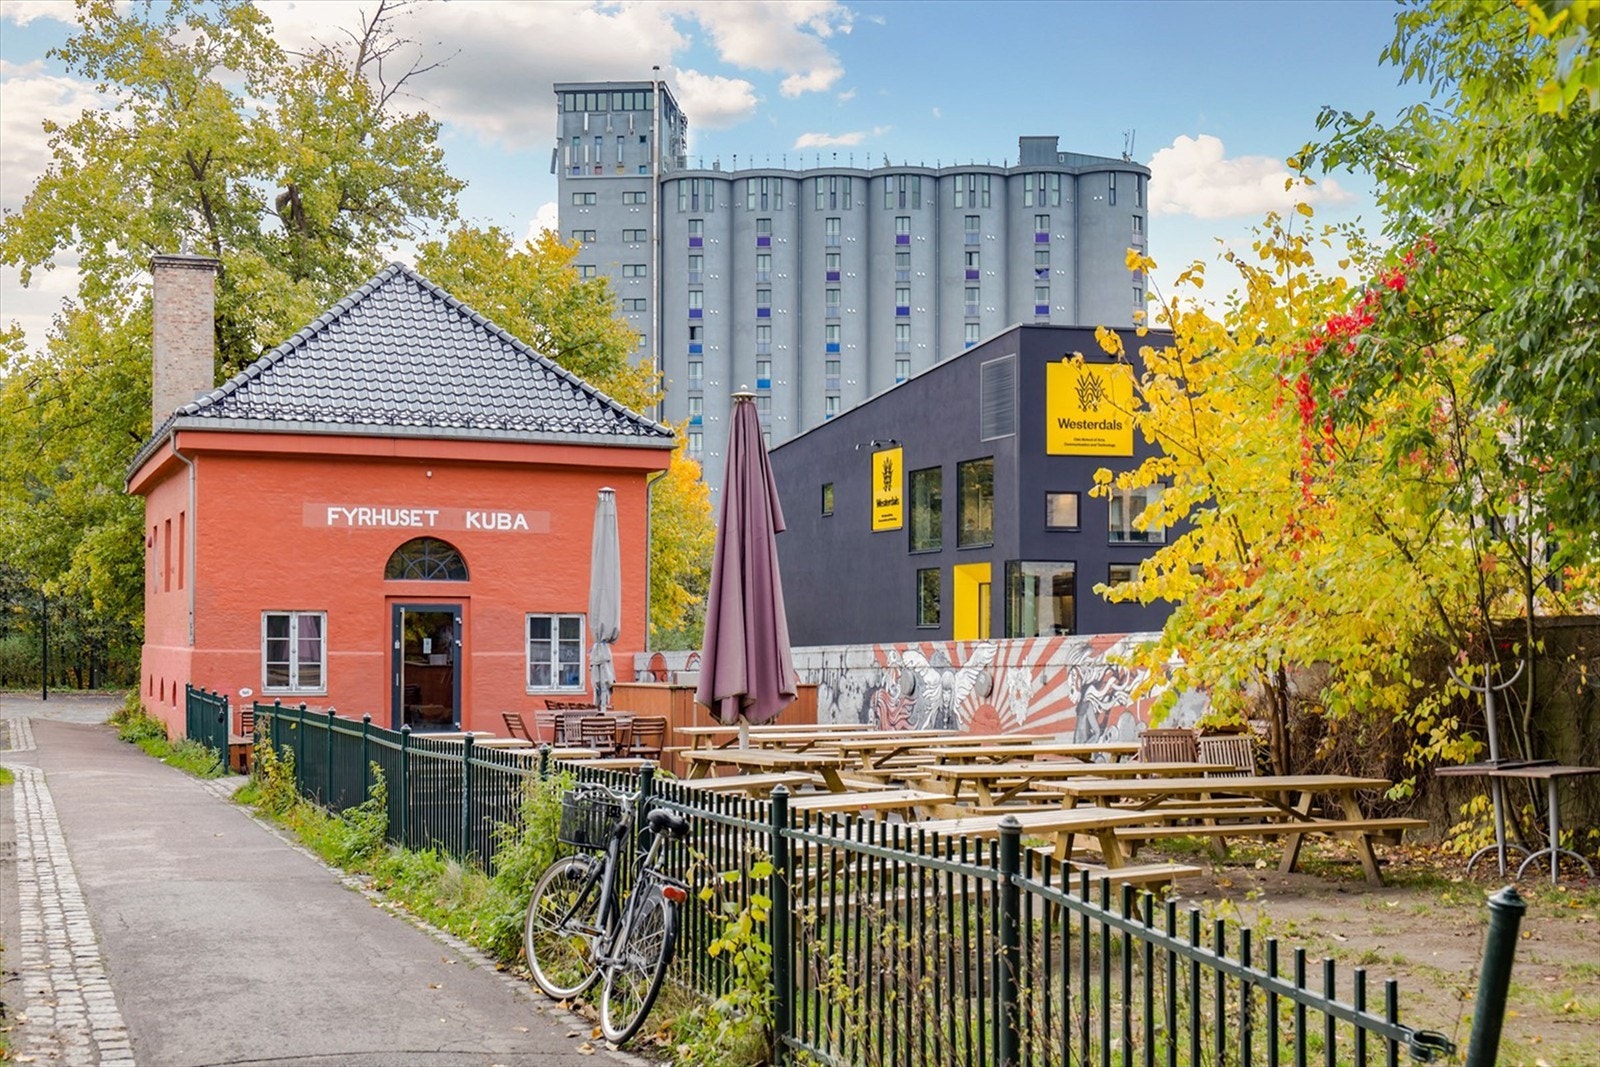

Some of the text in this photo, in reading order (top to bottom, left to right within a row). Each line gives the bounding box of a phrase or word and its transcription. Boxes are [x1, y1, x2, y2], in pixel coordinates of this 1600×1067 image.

[1058, 418, 1122, 430] Westerdals
[327, 506, 529, 530] FYRHUSET KUBA
